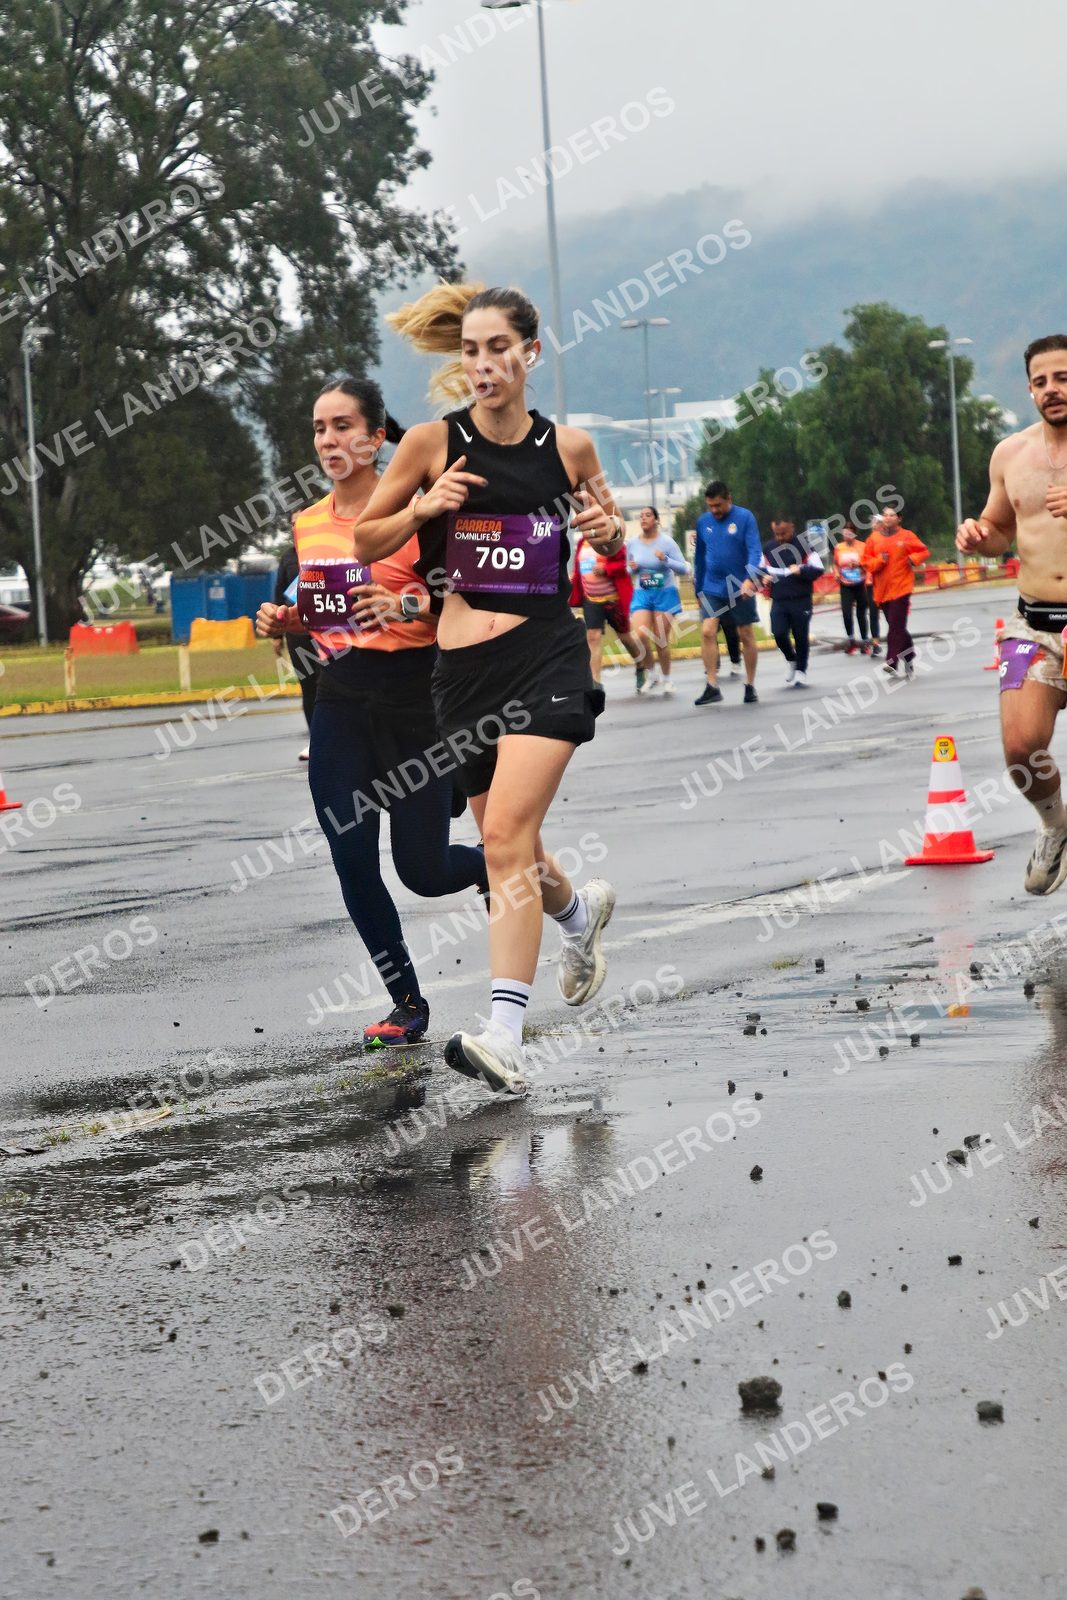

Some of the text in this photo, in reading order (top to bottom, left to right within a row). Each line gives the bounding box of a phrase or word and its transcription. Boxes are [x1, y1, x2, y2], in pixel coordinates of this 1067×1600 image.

[455, 518, 503, 532] CARRERA
[476, 546, 526, 570] 709
[313, 593, 347, 613] 543
